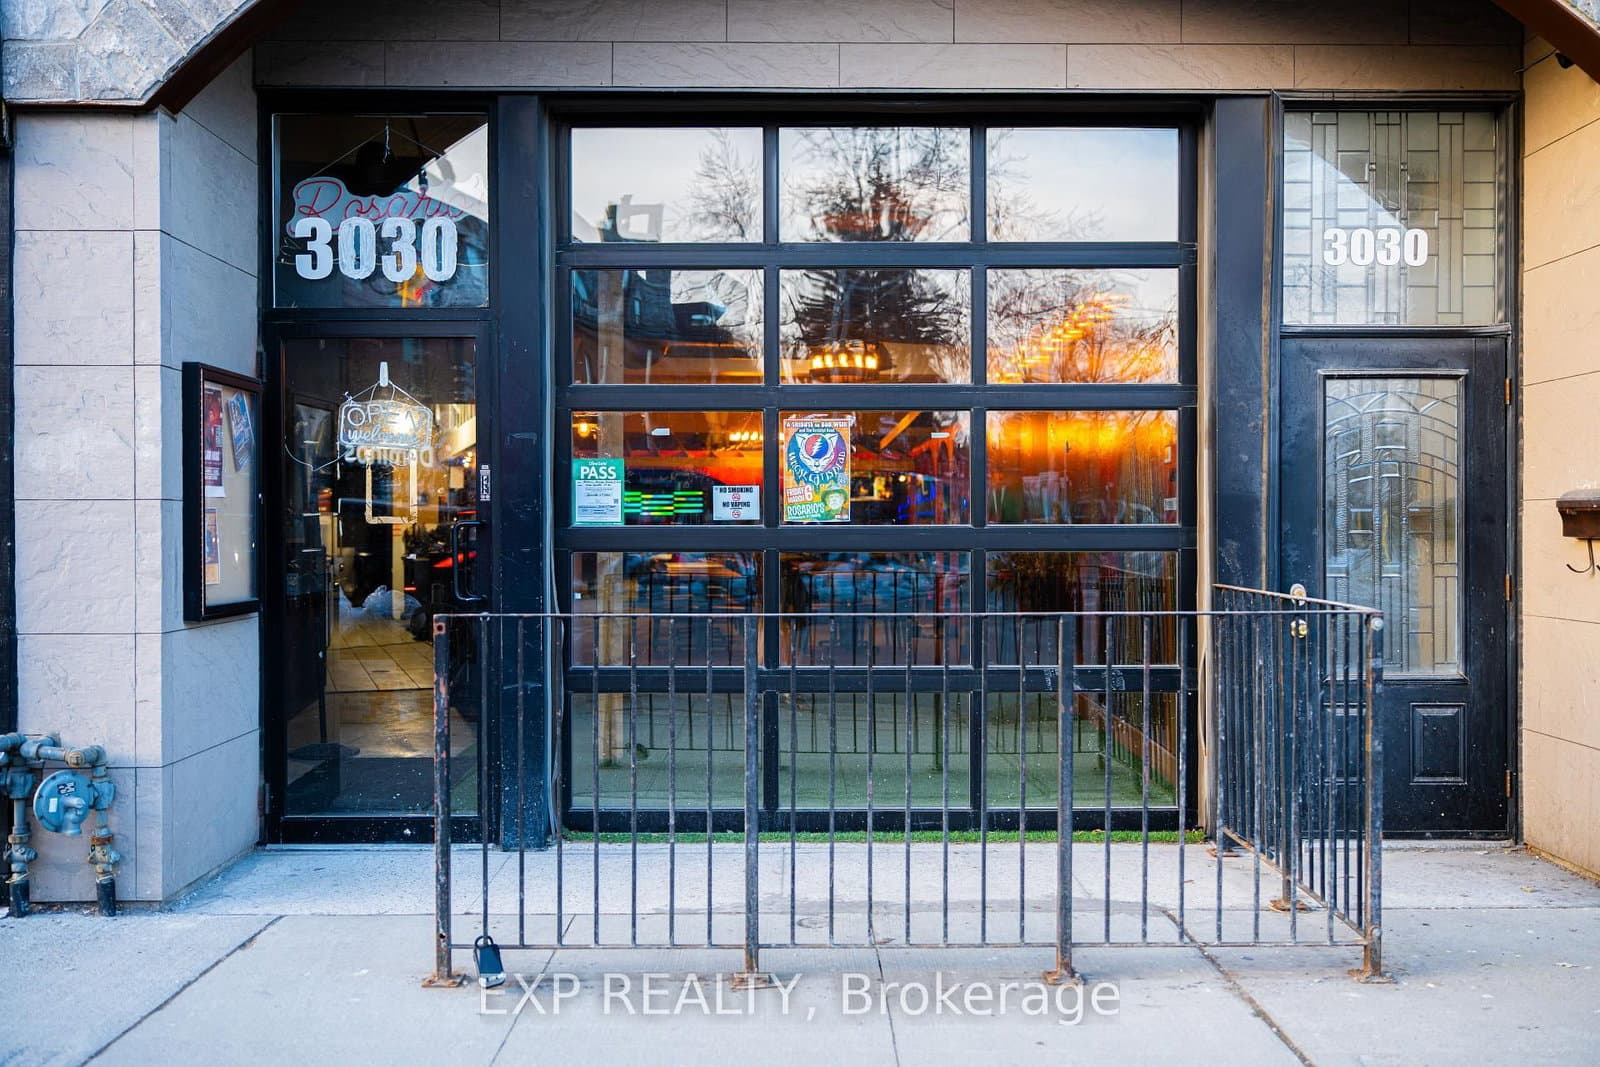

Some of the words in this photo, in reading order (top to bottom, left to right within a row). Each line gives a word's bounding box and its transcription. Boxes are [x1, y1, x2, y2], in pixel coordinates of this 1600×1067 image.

[295, 217, 458, 282] 3030
[1323, 228, 1429, 267] 3030
[580, 466, 617, 480] PASS
[805, 485, 813, 501] 6
[787, 502, 825, 516] ROSARIO'S
